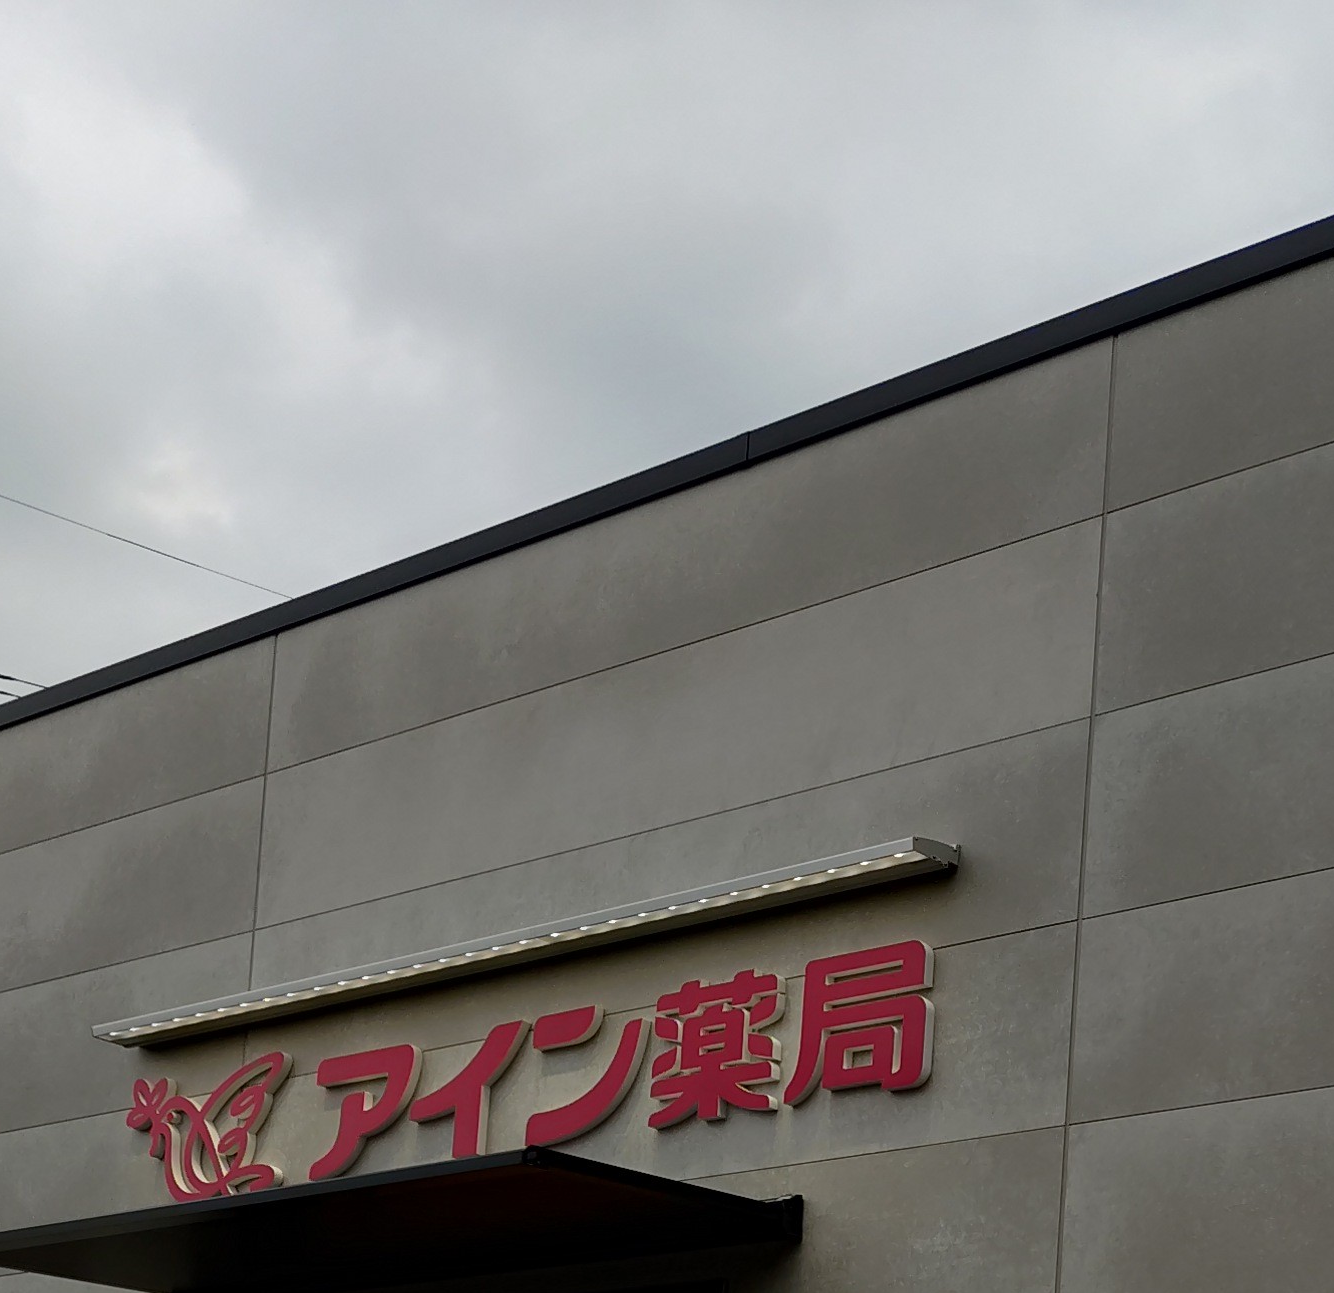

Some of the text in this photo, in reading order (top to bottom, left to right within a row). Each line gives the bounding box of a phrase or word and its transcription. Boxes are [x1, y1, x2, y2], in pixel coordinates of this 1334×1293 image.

[308, 940, 934, 1181] アイン薬局
